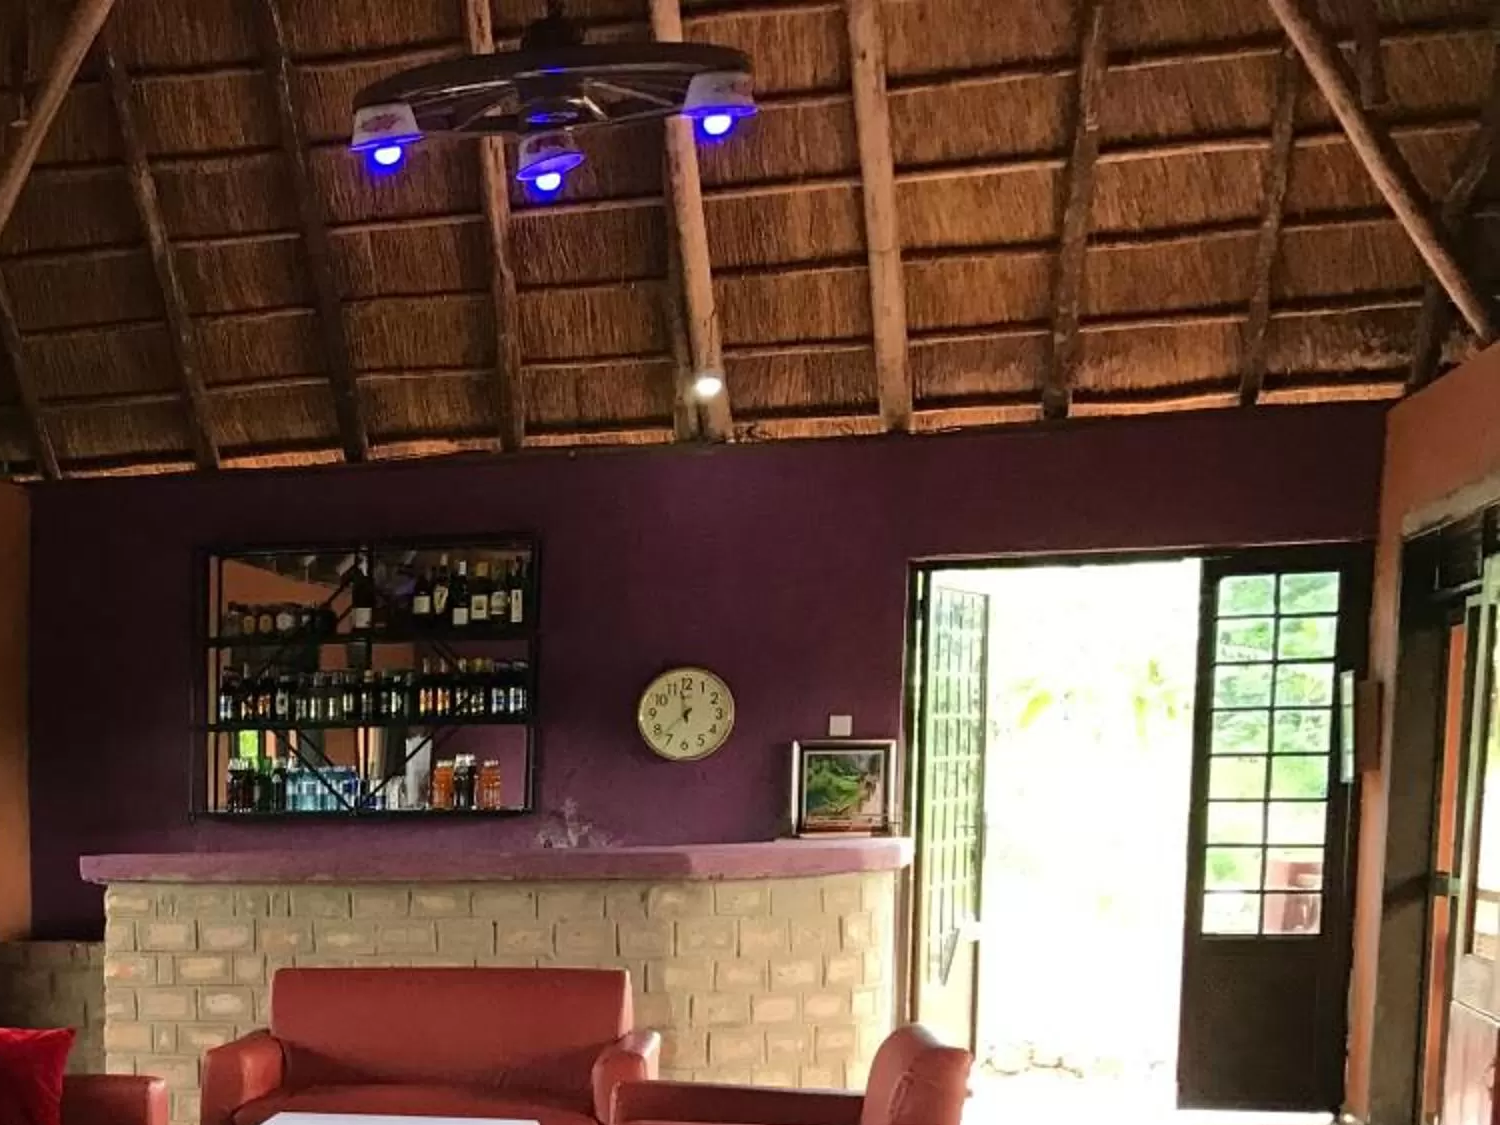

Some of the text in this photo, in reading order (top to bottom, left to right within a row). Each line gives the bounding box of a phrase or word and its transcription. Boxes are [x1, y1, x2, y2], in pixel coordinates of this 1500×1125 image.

[667, 682, 677, 696] 11
[681, 678, 693, 690] 12
[700, 681, 705, 694] 1
[655, 694, 668, 706] 10
[710, 692, 719, 705] 2
[648, 707, 657, 720] 9
[715, 707, 723, 720] 3
[665, 734, 674, 746] 7
[697, 734, 705, 747] 5
